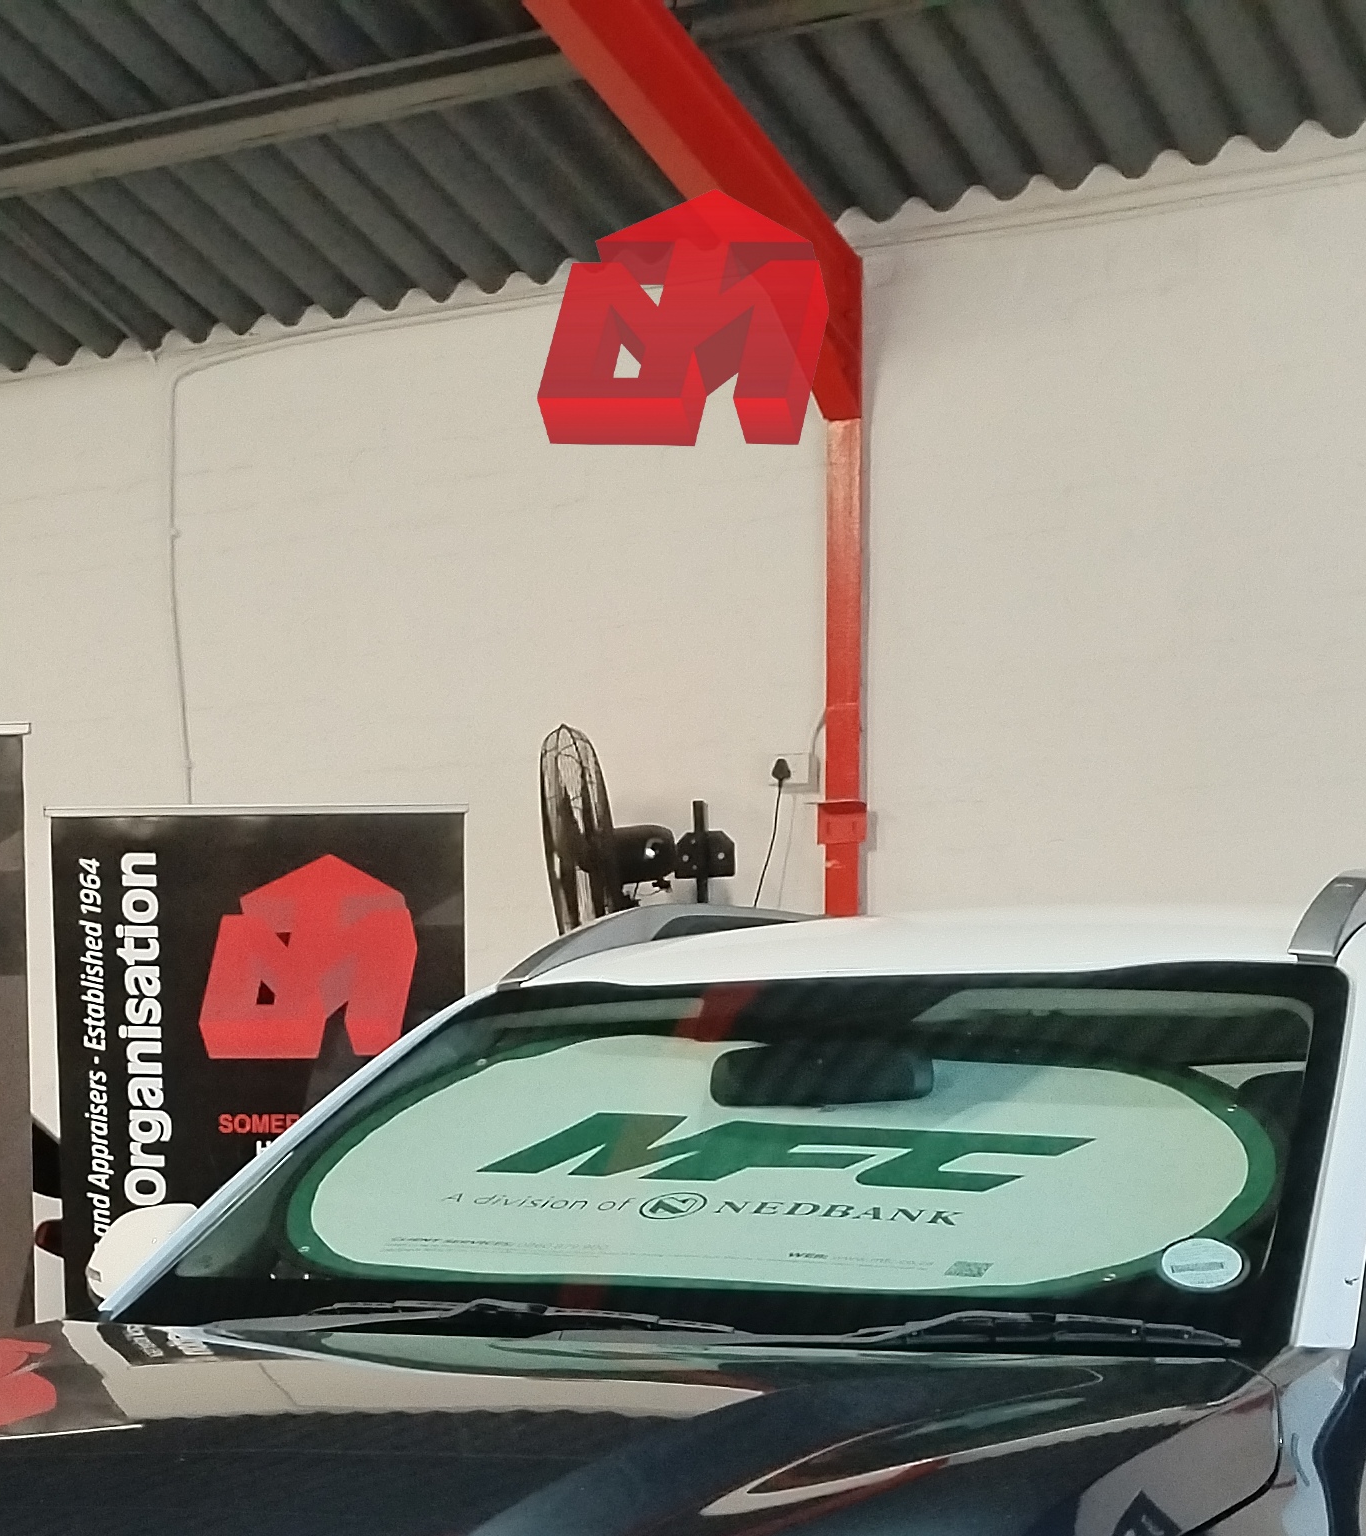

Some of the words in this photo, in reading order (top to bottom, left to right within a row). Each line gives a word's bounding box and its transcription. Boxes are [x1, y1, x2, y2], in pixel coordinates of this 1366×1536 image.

[78, 857, 102, 915] 1964
[78, 919, 107, 1052] Established
[85, 1068, 115, 1190] Appraisers
[475, 1111, 1097, 1192] MFC
[86, 1192, 112, 1237] and
[443, 1193, 463, 1203] A
[473, 1193, 588, 1210] division
[597, 1197, 637, 1211] of
[713, 1200, 963, 1227] NEDBANK
